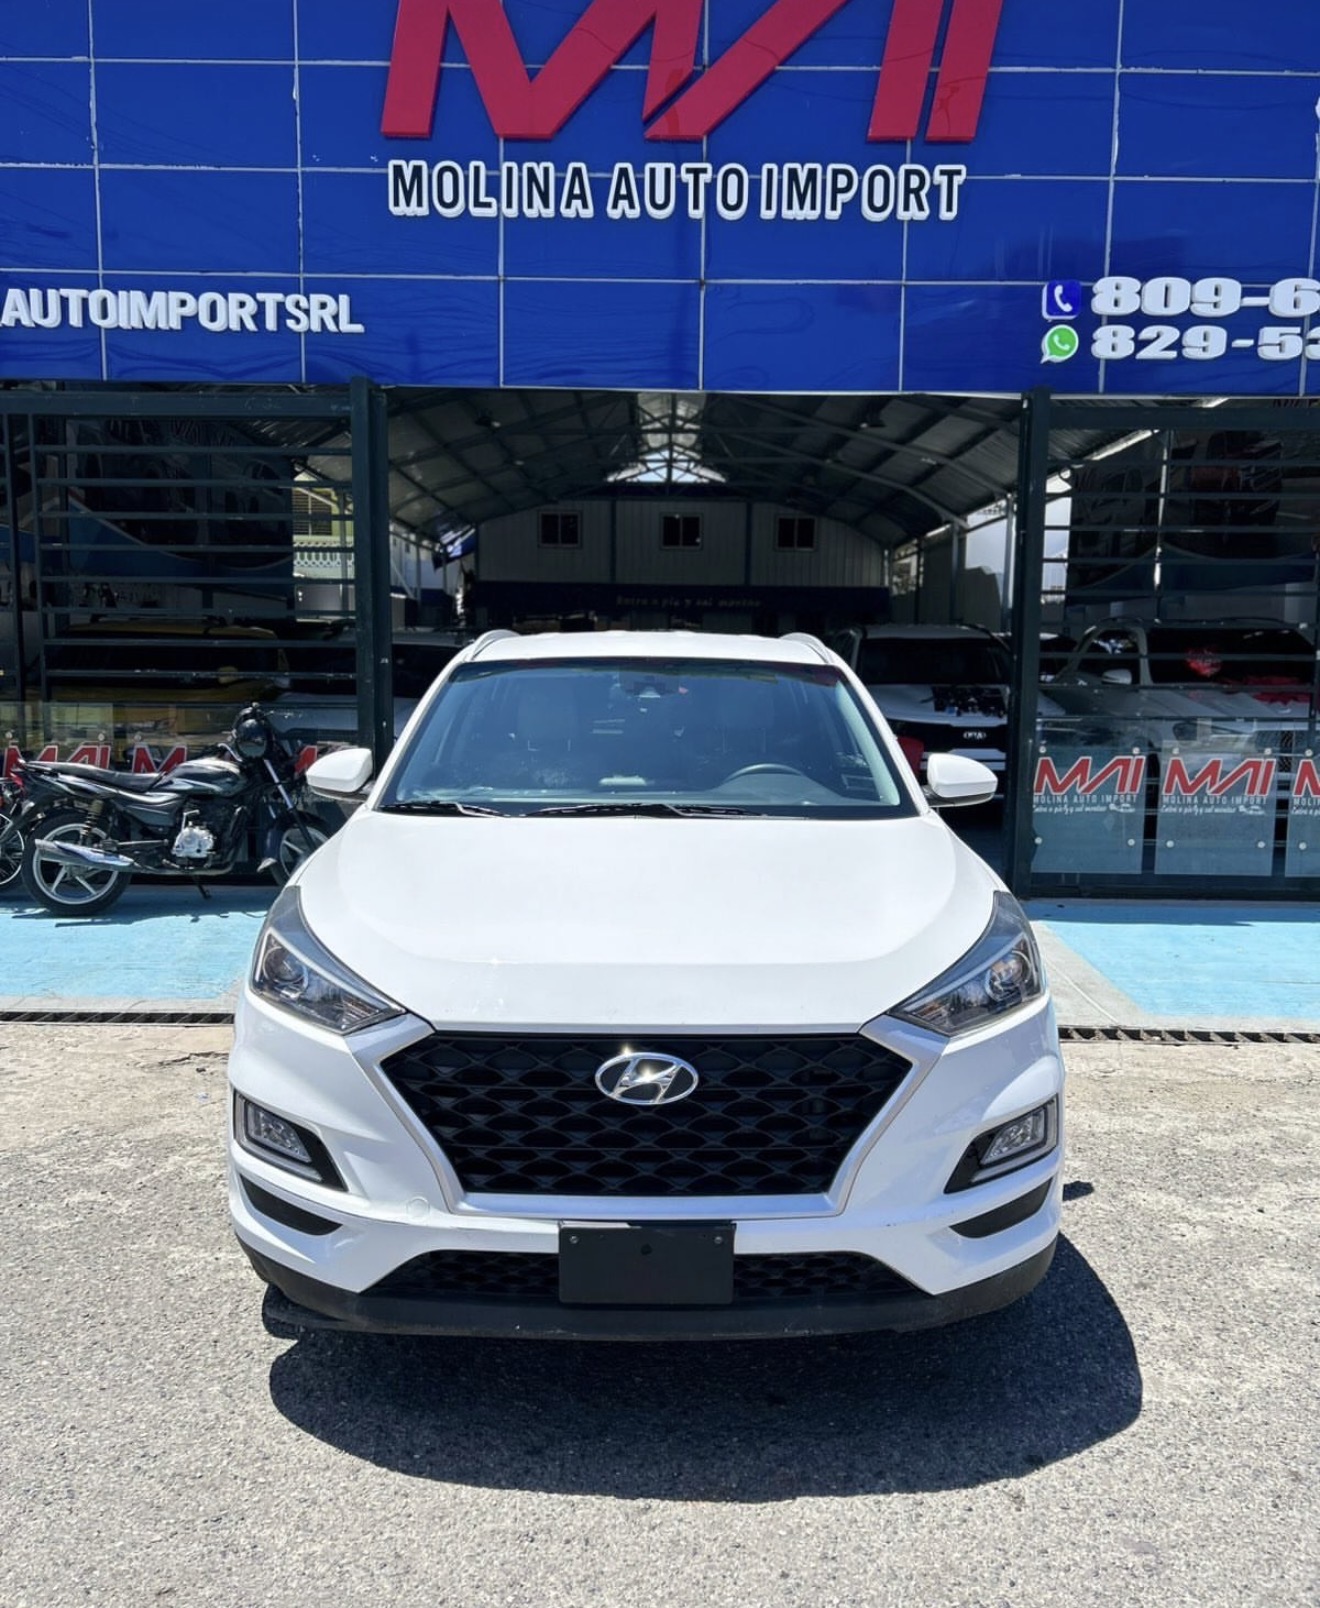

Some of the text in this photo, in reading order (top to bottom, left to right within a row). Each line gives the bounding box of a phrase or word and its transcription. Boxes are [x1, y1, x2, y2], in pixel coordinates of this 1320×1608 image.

[380, 0, 1002, 141] MAI
[388, 160, 967, 222] MOLINA AUTO IMPORT
[0, 288, 365, 333] AUTOIMPORTSRL
[1033, 756, 1146, 795] MAI
[1162, 757, 1277, 796] MAI
[1033, 794, 1137, 804] MOLINA AUTO IMPORT
[1162, 795, 1267, 805] MOLINA AUTO IMPORT
